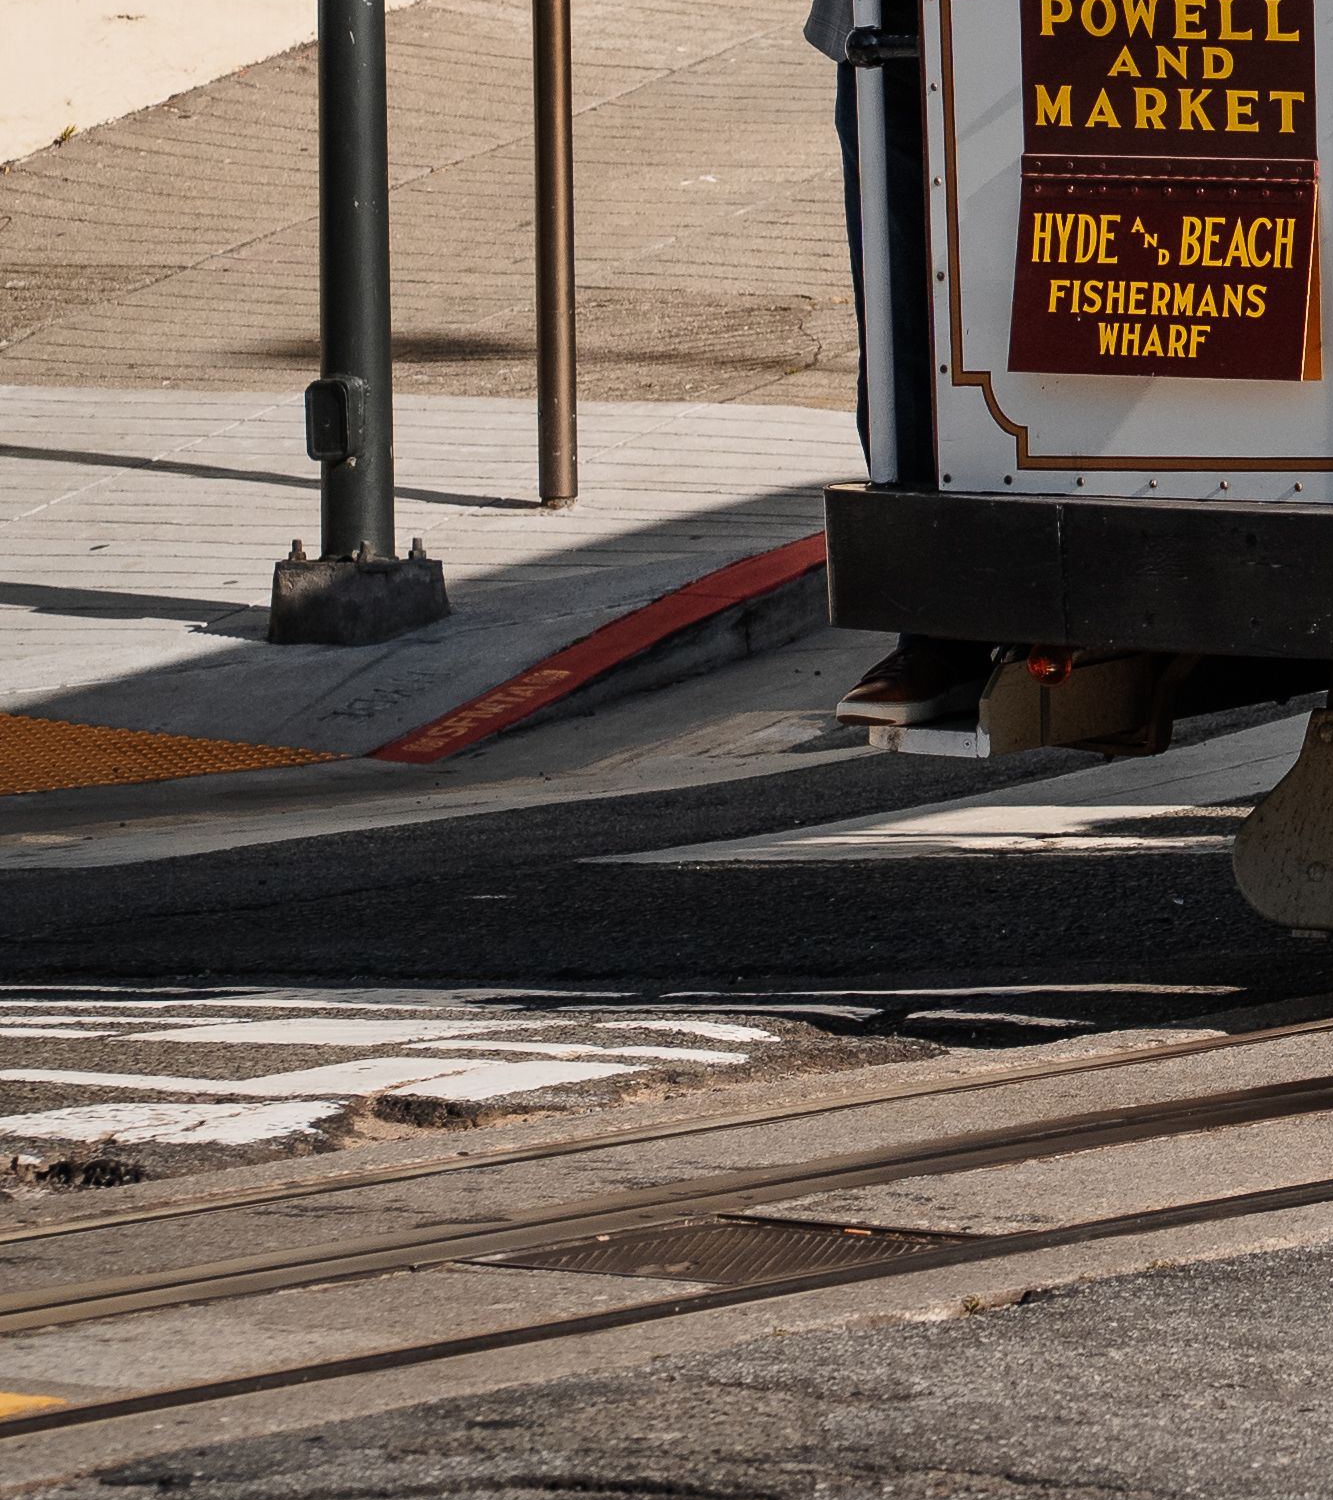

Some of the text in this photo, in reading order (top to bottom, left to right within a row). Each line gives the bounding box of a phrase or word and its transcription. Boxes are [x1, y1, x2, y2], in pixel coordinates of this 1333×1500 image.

[1107, 45, 1234, 80] AND
[1033, 84, 1306, 134] MARKET
[1031, 213, 1295, 269] HYDE AND BEACH
[1047, 280, 1267, 319] FISHERMANS
[1097, 323, 1210, 359] WHARF
